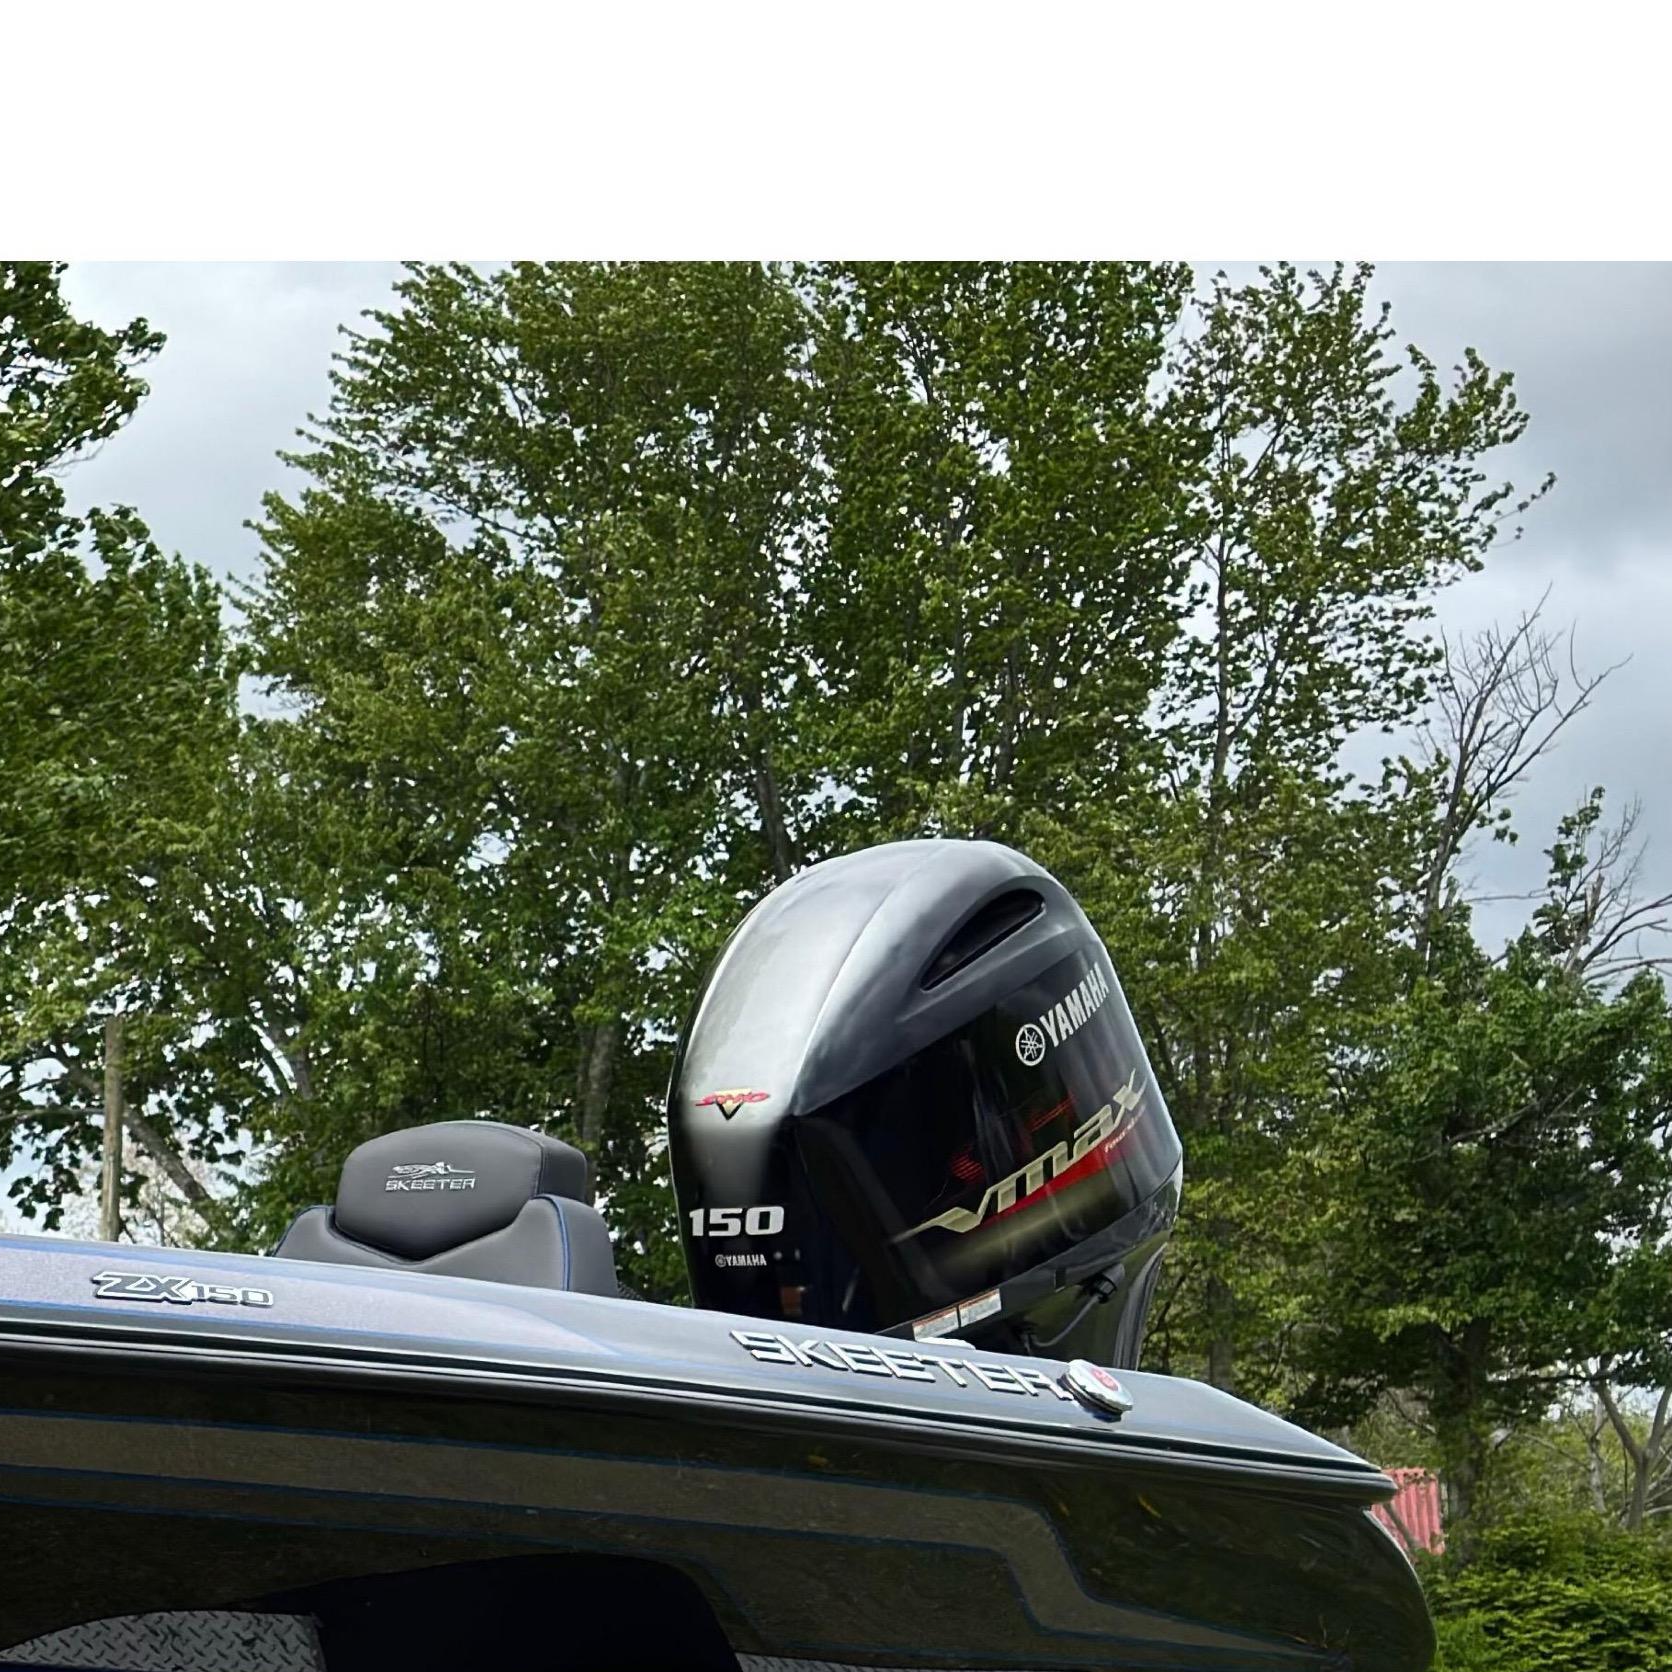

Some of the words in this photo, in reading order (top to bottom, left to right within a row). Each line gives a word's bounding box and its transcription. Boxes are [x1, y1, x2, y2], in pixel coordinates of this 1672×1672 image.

[1039, 961, 1110, 1048] YAMAHA
[385, 1178, 476, 1191] SKEETER
[688, 1205, 785, 1237] 150
[724, 1253, 767, 1267] YAMAHA
[729, 1328, 1075, 1401] SKEETER
